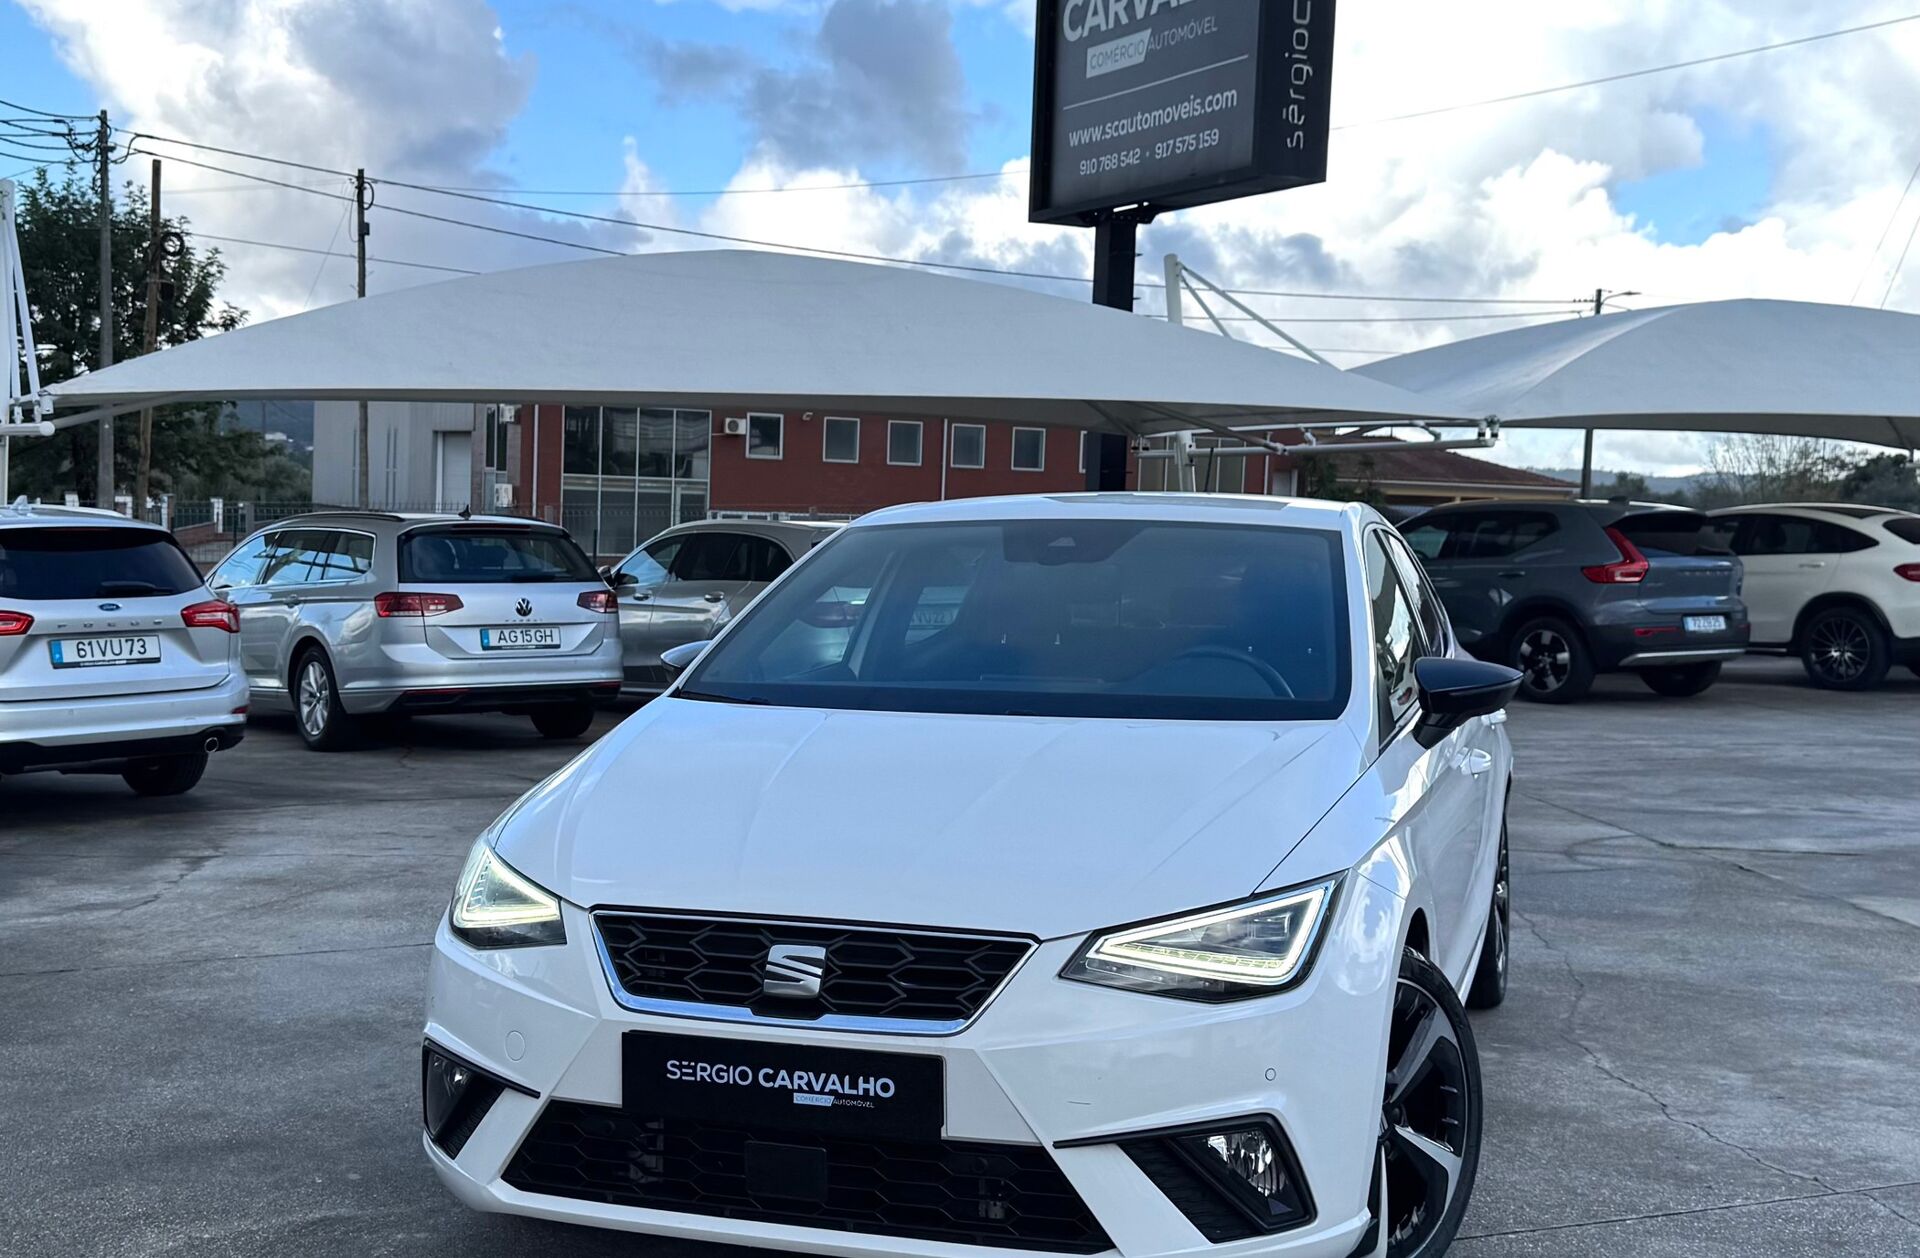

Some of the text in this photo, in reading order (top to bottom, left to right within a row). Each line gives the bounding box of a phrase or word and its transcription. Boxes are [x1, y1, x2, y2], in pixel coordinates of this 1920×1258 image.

[1090, 16, 1219, 70] COMÉRCIO AUTOMÓVEL
[1069, 89, 1238, 147] www.scautomoveis.com
[1079, 128, 1220, 175] 910 768 542 917 575 159
[758, 1068, 895, 1098] CARVALHO
